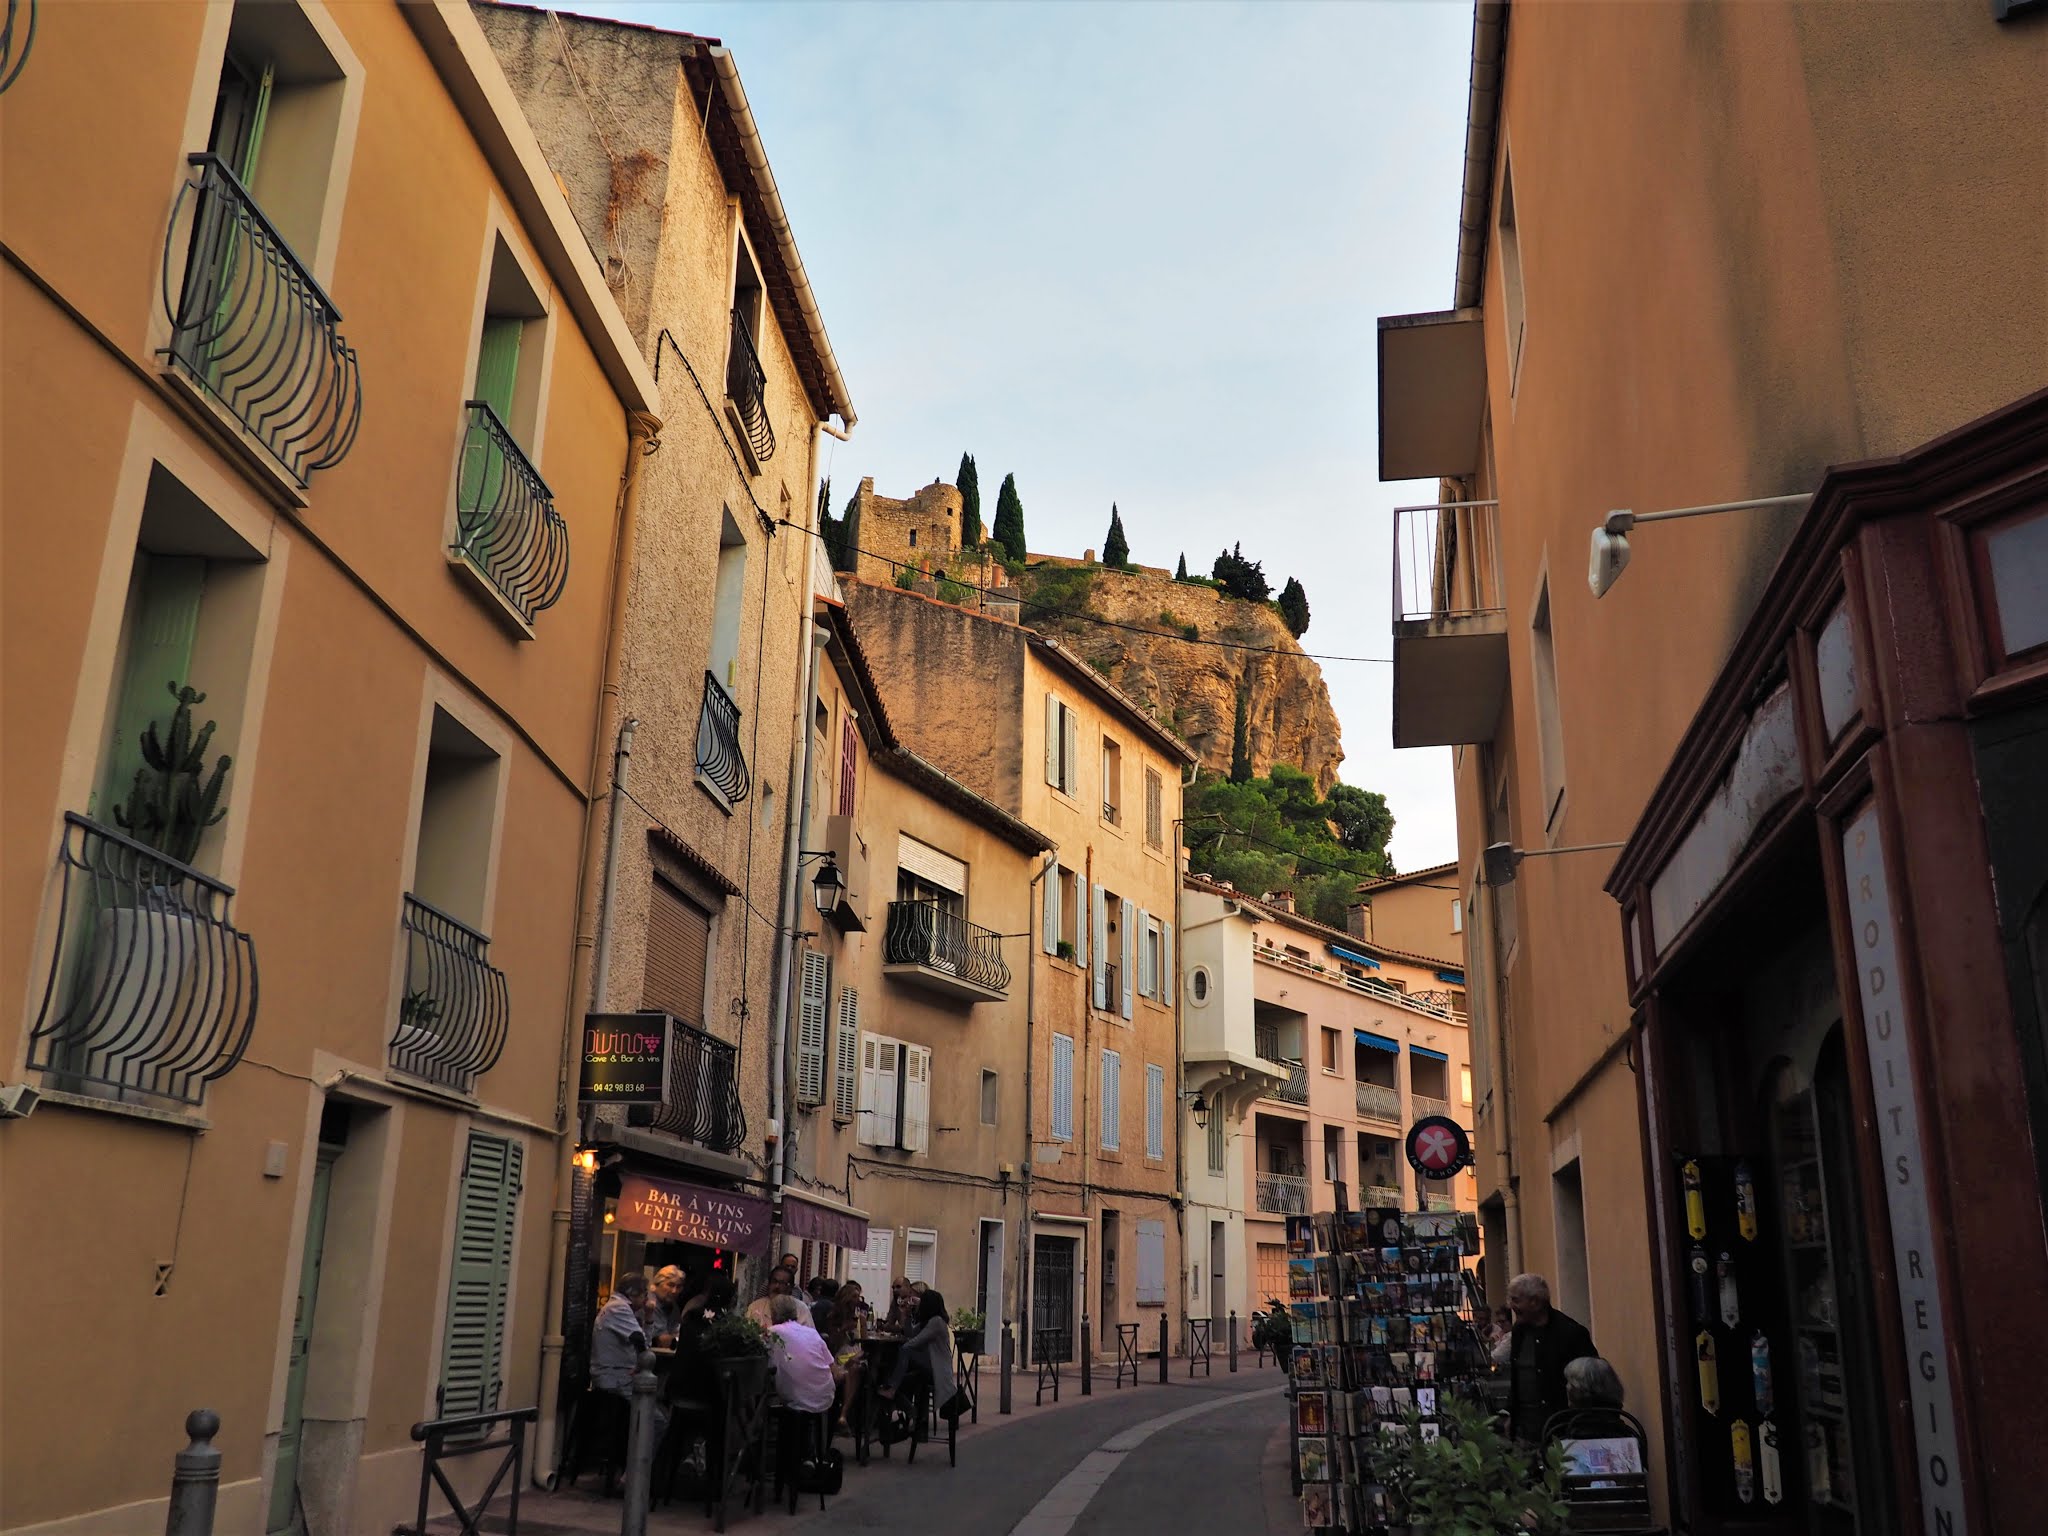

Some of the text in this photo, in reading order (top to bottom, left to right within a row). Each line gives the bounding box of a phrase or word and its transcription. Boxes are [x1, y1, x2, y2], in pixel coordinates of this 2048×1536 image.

[1855, 830, 1910, 1185] PRODUITS
[584, 1054, 607, 1063] Cave
[610, 1054, 617, 1063] &
[620, 1054, 635, 1063] Bar
[647, 1055, 660, 1063] vins
[593, 1083, 645, 1092] 04 42 98 83 68
[634, 1201, 753, 1235] VENTE DE VINS
[648, 1189, 744, 1219] BAR À VINS
[650, 1218, 729, 1245] DE CASSIS
